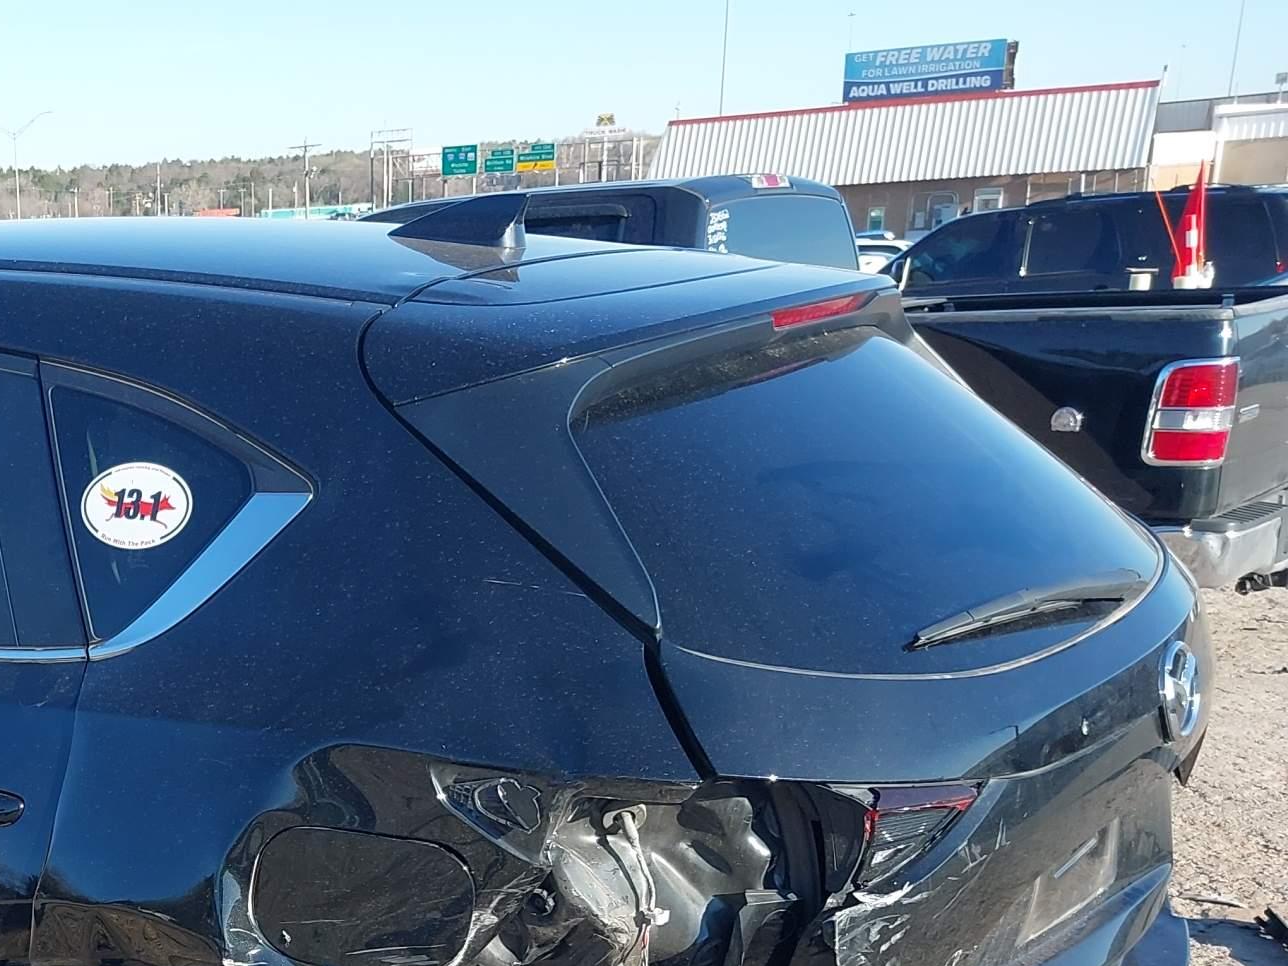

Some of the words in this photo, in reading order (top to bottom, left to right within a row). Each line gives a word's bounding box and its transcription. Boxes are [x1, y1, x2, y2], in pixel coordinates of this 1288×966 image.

[854, 53, 874, 63] GET
[875, 49, 922, 66] FREE
[926, 42, 992, 62] WATER
[862, 69, 882, 78] FOR
[885, 65, 916, 76] LAWN
[917, 60, 981, 73] IRRIGATION
[849, 84, 887, 98] AQUA
[889, 81, 926, 94] WELL
[927, 75, 991, 91] DRILLING
[114, 488, 162, 521] 13.1
